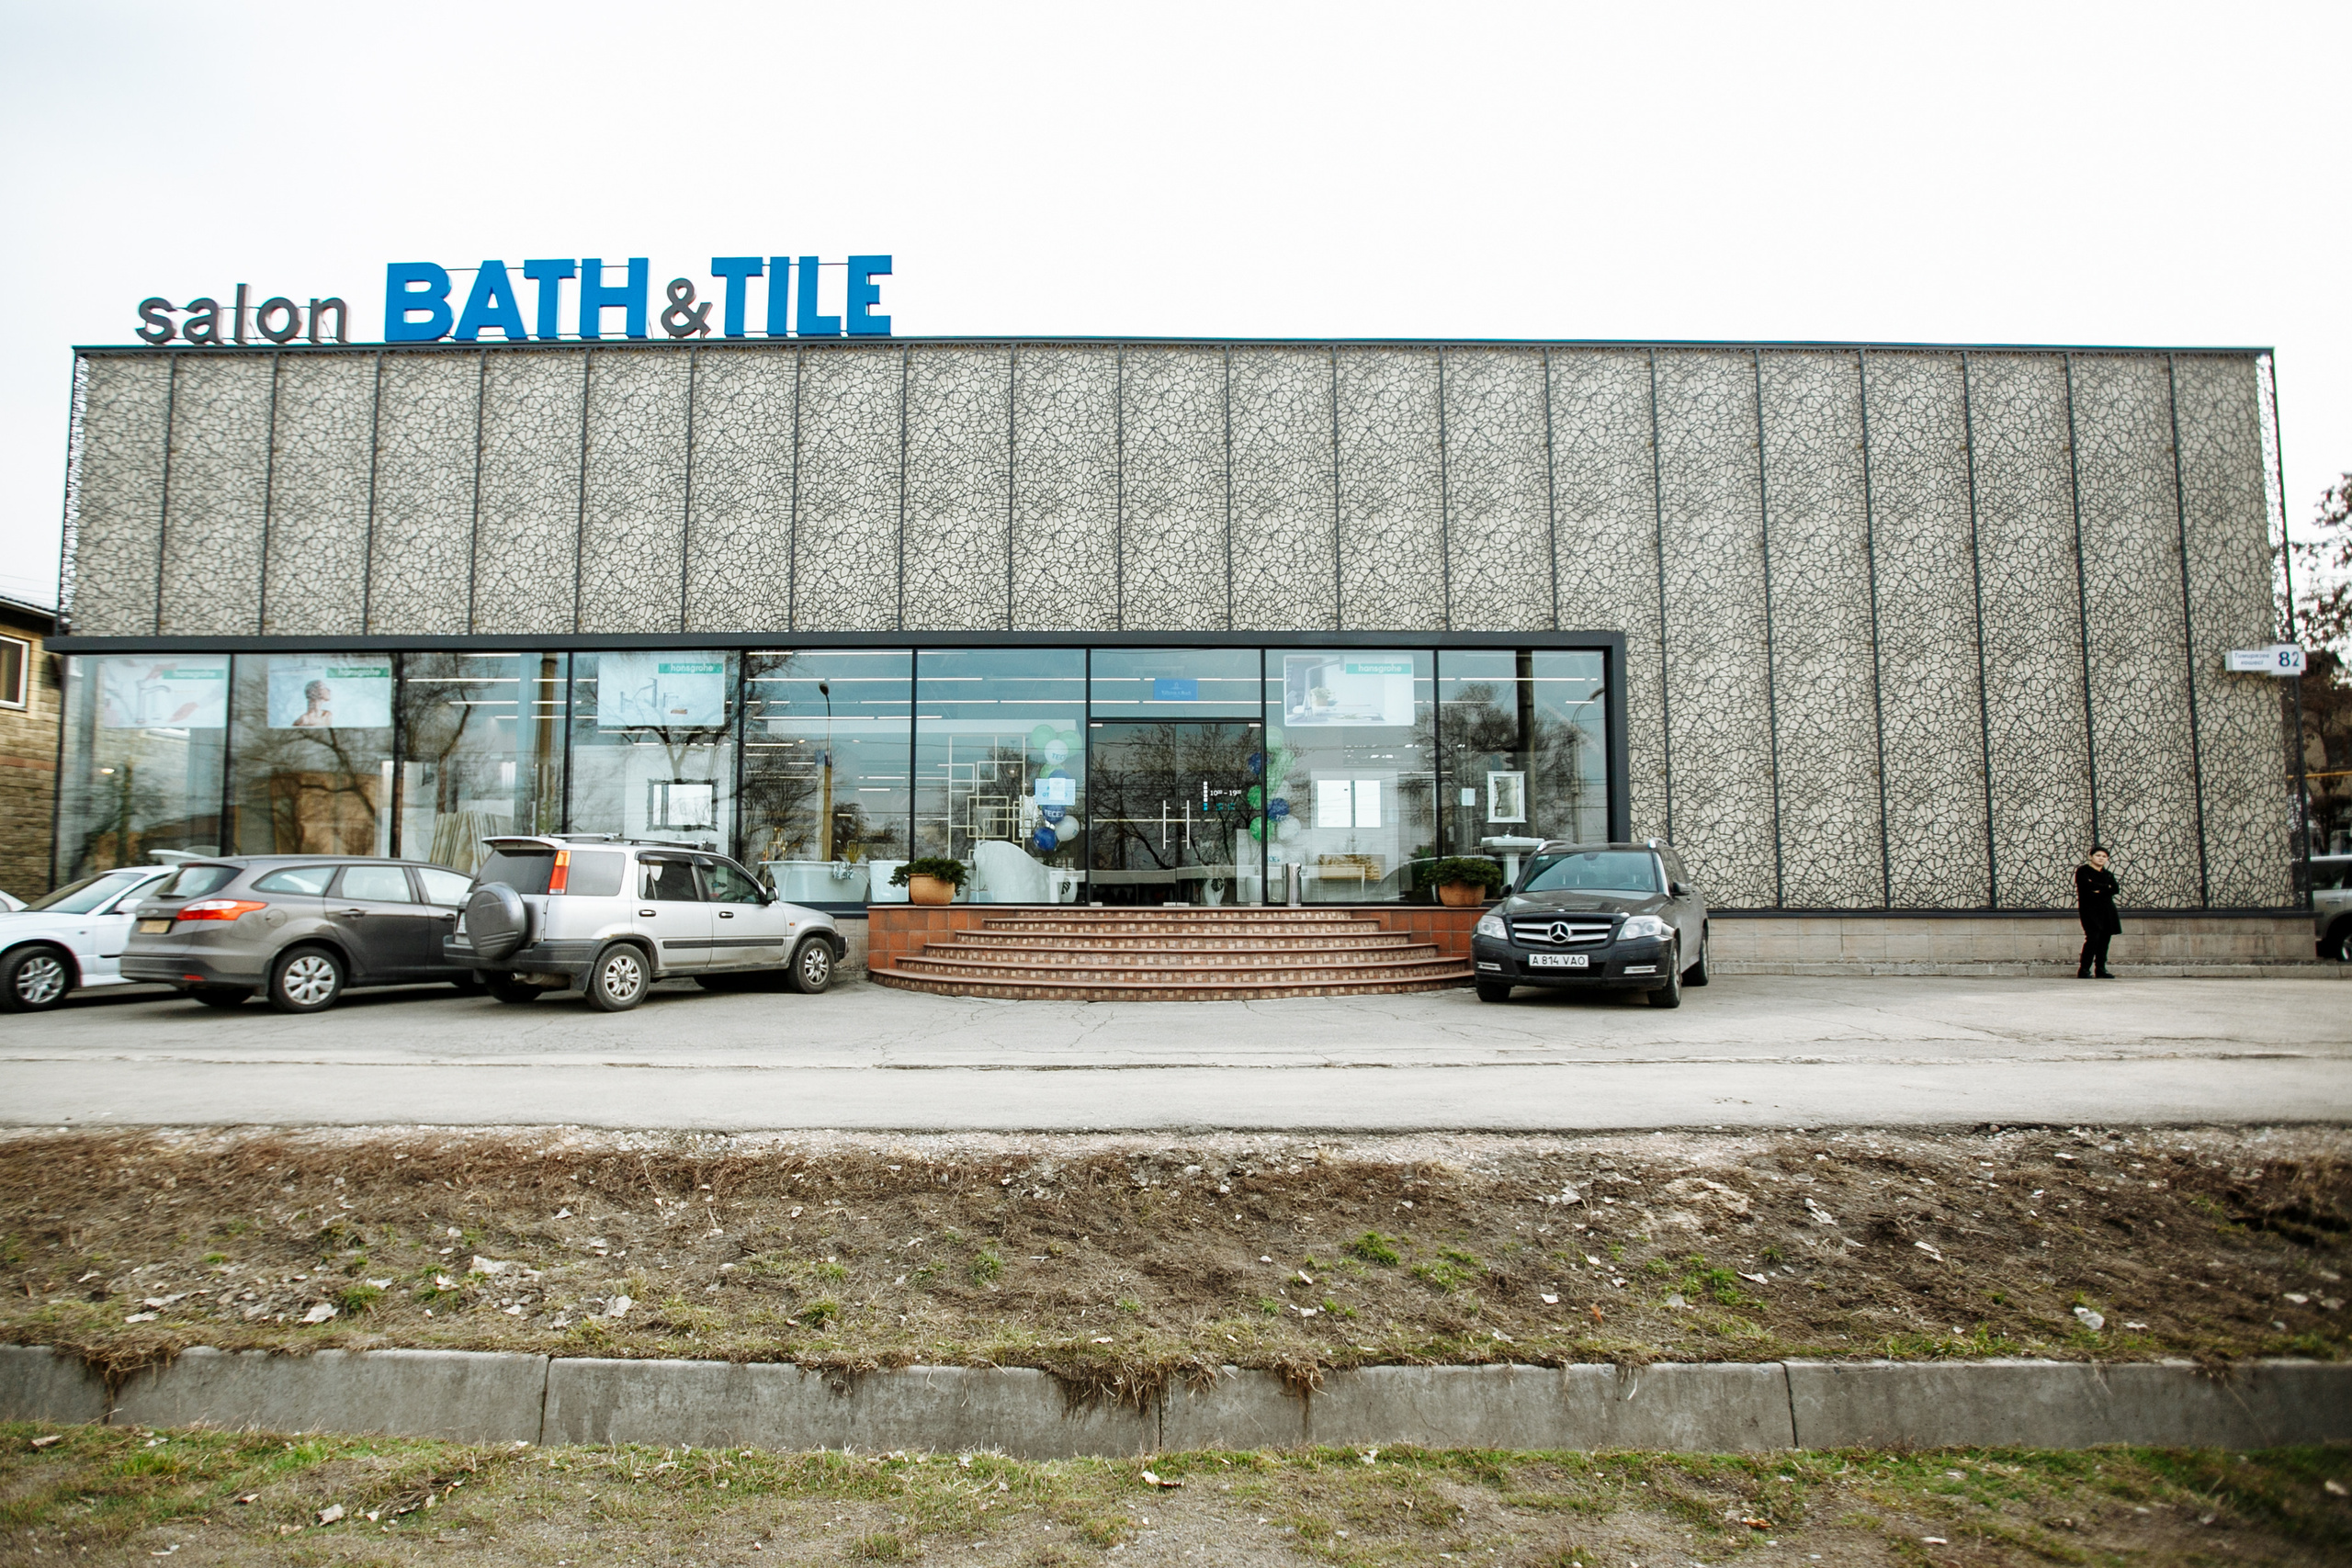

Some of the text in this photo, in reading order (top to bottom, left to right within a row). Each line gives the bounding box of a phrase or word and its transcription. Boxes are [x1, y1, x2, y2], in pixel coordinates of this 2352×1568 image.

[136, 283, 349, 344] salon
[2278, 650, 2300, 667] 82
[671, 662, 713, 673] hansgrohe
[1358, 663, 1402, 674] hansgrohe
[1532, 956, 1586, 965] A 814 VAO
